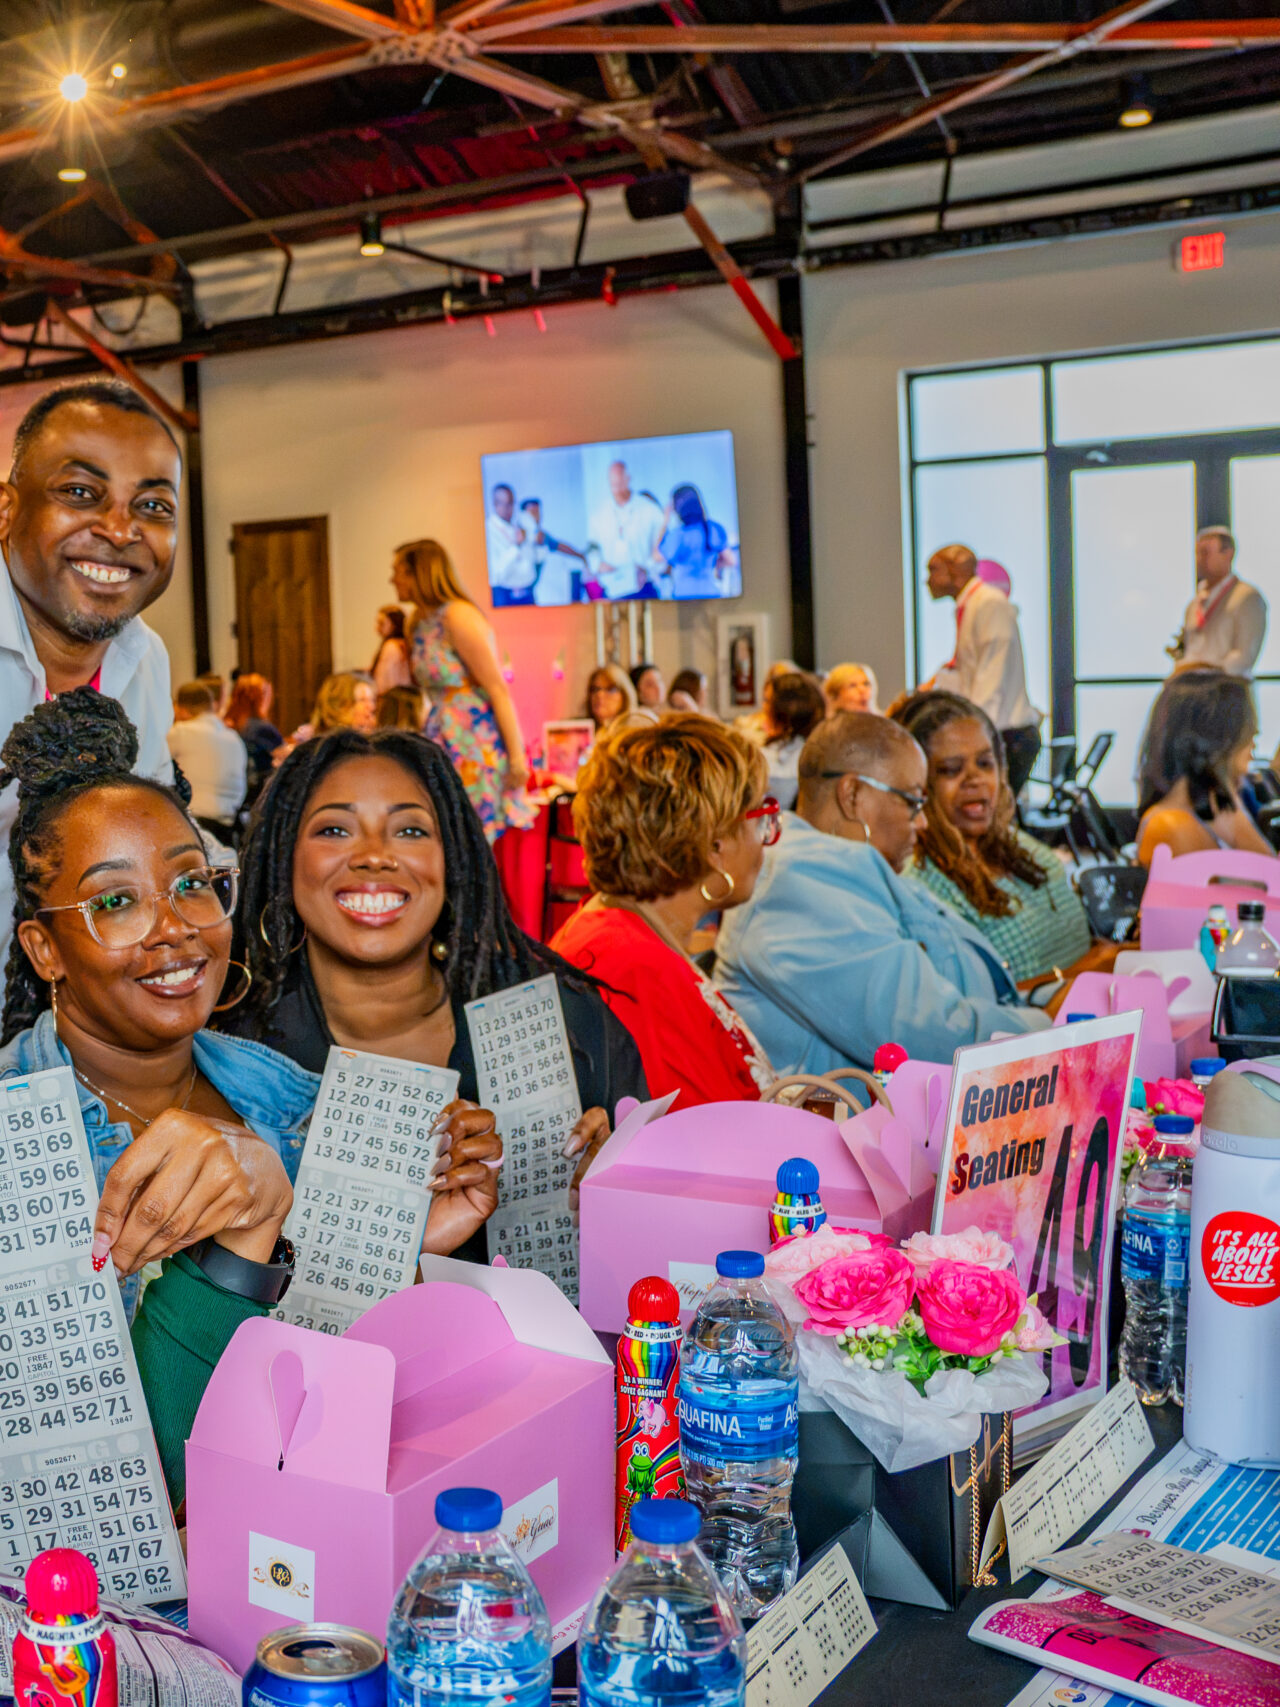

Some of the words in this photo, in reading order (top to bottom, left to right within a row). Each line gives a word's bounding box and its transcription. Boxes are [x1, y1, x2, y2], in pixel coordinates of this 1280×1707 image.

[478, 1023, 490, 1036] 13
[494, 1017, 507, 1030] 23
[510, 1011, 523, 1024] 34
[525, 1004, 538, 1017] 53
[541, 998, 553, 1012] 70
[482, 1040, 494, 1054] 11
[498, 1034, 510, 1048] 29
[514, 1028, 527, 1041] 33
[530, 1022, 542, 1035] 54
[545, 1016, 557, 1029] 73
[485, 1058, 497, 1071] 12
[501, 1052, 514, 1066] 26
[534, 1040, 546, 1053] 58
[549, 1034, 561, 1046] 75
[329, 1089, 346, 1102] 12
[351, 1094, 369, 1107] 20
[375, 1099, 390, 1112] 41
[399, 1105, 416, 1117] 49
[337, 1072, 345, 1083] 5
[355, 1076, 374, 1088] 27
[379, 1081, 397, 1093] 37
[403, 1086, 421, 1099] 52
[426, 1091, 443, 1105] 62
[961, 1065, 1059, 1128] General
[8, 1111, 34, 1131] 58
[41, 1104, 66, 1124] 61
[324, 1107, 342, 1120] 10
[347, 1112, 364, 1125] 16
[394, 1122, 411, 1135] 55
[14, 1140, 40, 1160] 53
[47, 1132, 72, 1152] 69
[324, 1127, 332, 1137] 9
[343, 1131, 360, 1143] 17
[366, 1137, 383, 1149] 45
[390, 1141, 407, 1154] 56
[413, 1146, 430, 1161] 72
[20, 1168, 46, 1188] 59
[53, 1160, 79, 1181] 66
[314, 1144, 332, 1157] 13
[337, 1149, 355, 1163] 29
[361, 1155, 379, 1169] 32
[385, 1160, 401, 1174] 51
[408, 1165, 425, 1180] 65
[951, 1136, 1046, 1195] Seating
[27, 1196, 53, 1217] 60
[59, 1189, 85, 1210] 75
[0, 1233, 24, 1253] 31
[33, 1224, 56, 1245] 57
[66, 1217, 91, 1238] 64
[1212, 1229, 1243, 1246] IT'S
[1246, 1231, 1278, 1247] ALL
[1211, 1245, 1280, 1265] ABOUT
[4, 1279, 37, 1292] 9052671
[1211, 1263, 1275, 1283] JESUS.
[15, 1299, 39, 1318] 41
[47, 1291, 73, 1311] 51
[79, 1283, 105, 1304] 70
[21, 1327, 46, 1347] 33
[53, 1319, 80, 1339] 55
[86, 1311, 112, 1332] 73
[26, 1353, 48, 1363] FREE
[26, 1360, 54, 1374] 13847
[60, 1347, 86, 1368] 54
[93, 1339, 119, 1360] 65
[0, 1390, 25, 1409] 25
[33, 1383, 58, 1402] 39
[66, 1375, 93, 1395] 56
[100, 1368, 125, 1387] 66
[6, 1417, 31, 1437] 28
[40, 1410, 65, 1428] 44
[73, 1403, 99, 1423] 52
[105, 1396, 131, 1416] 71
[110, 1414, 134, 1426] 13847
